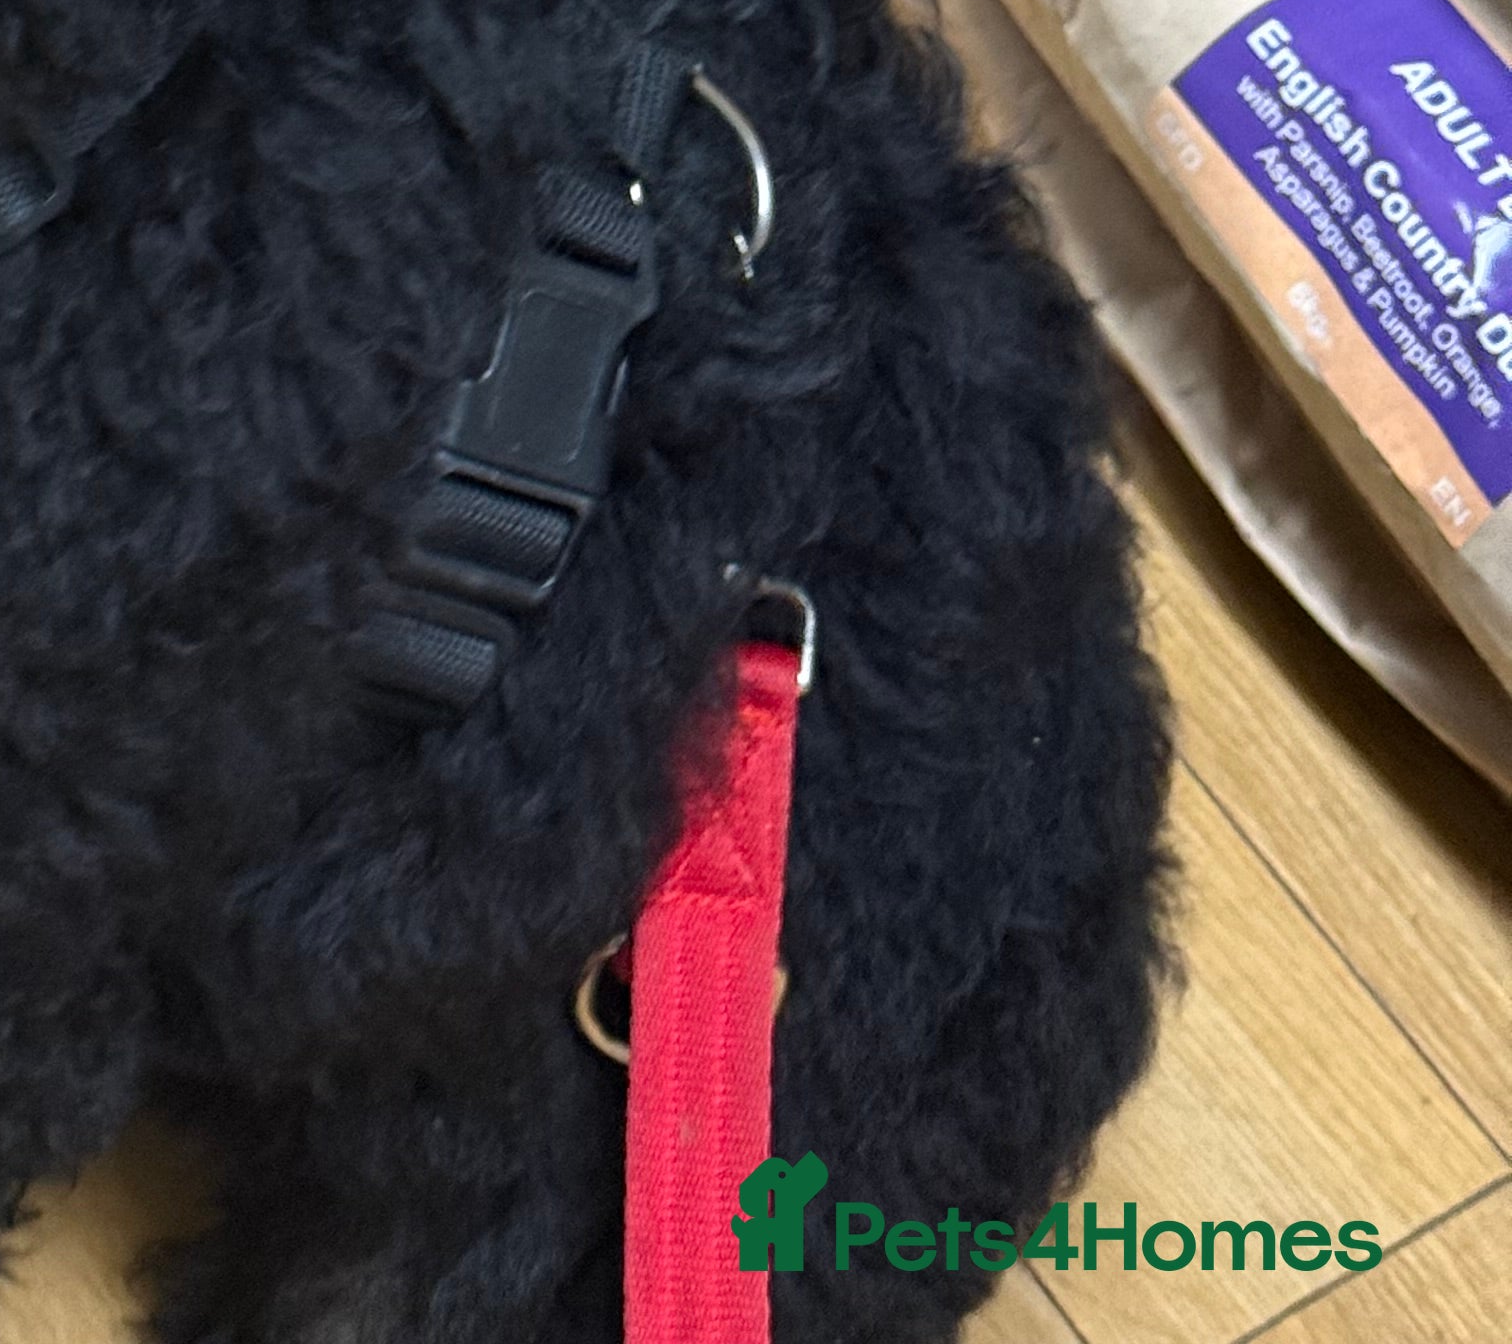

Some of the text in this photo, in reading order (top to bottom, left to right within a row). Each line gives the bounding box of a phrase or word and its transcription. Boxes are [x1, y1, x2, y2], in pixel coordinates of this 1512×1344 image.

[1246, 17, 1372, 170] English
[1363, 159, 1487, 319] Country
[1390, 61, 1512, 188] ADULT
[1236, 75, 1505, 429] with Parsnip, Beetroot, Orange,
[1253, 147, 1458, 401] Asparagus & Pumpkin
[1429, 476, 1471, 528] EN
